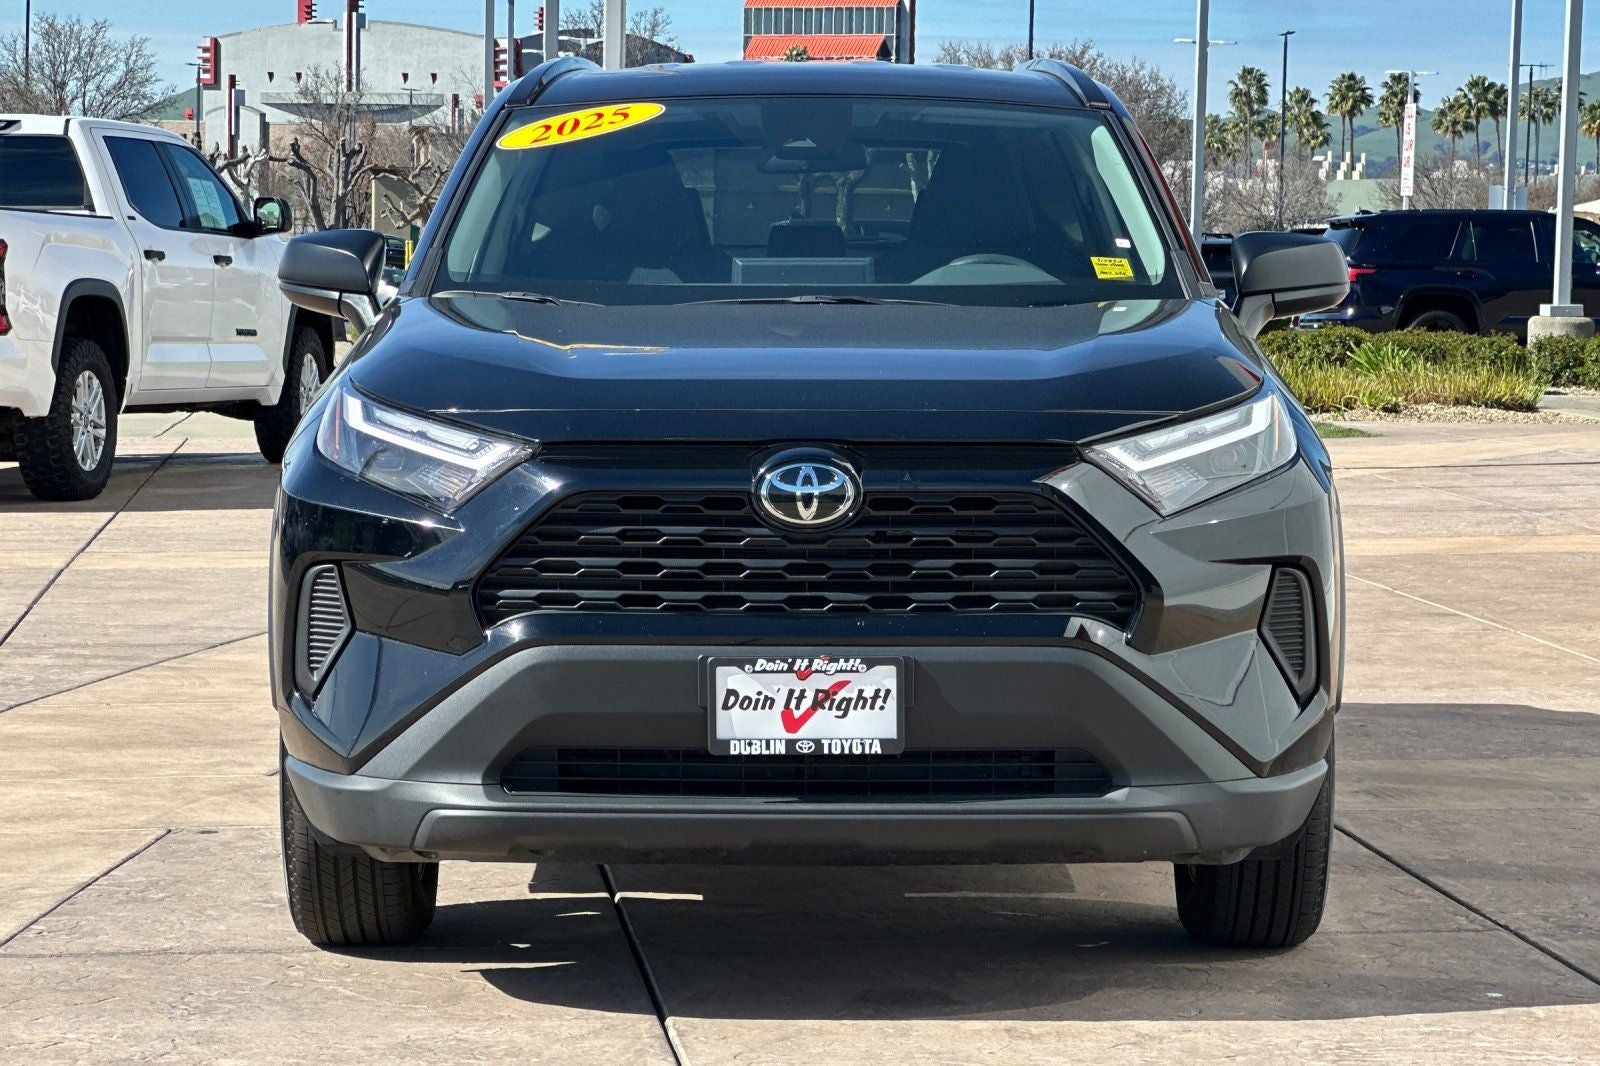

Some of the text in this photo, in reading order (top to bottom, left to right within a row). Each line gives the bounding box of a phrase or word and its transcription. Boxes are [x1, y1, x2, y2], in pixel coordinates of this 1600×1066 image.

[529, 107, 631, 144] 2025
[754, 658, 862, 675] Doin' It Right!
[721, 688, 892, 719] Doin' It Right!
[730, 739, 882, 755] DUBLIN TOYOTA
